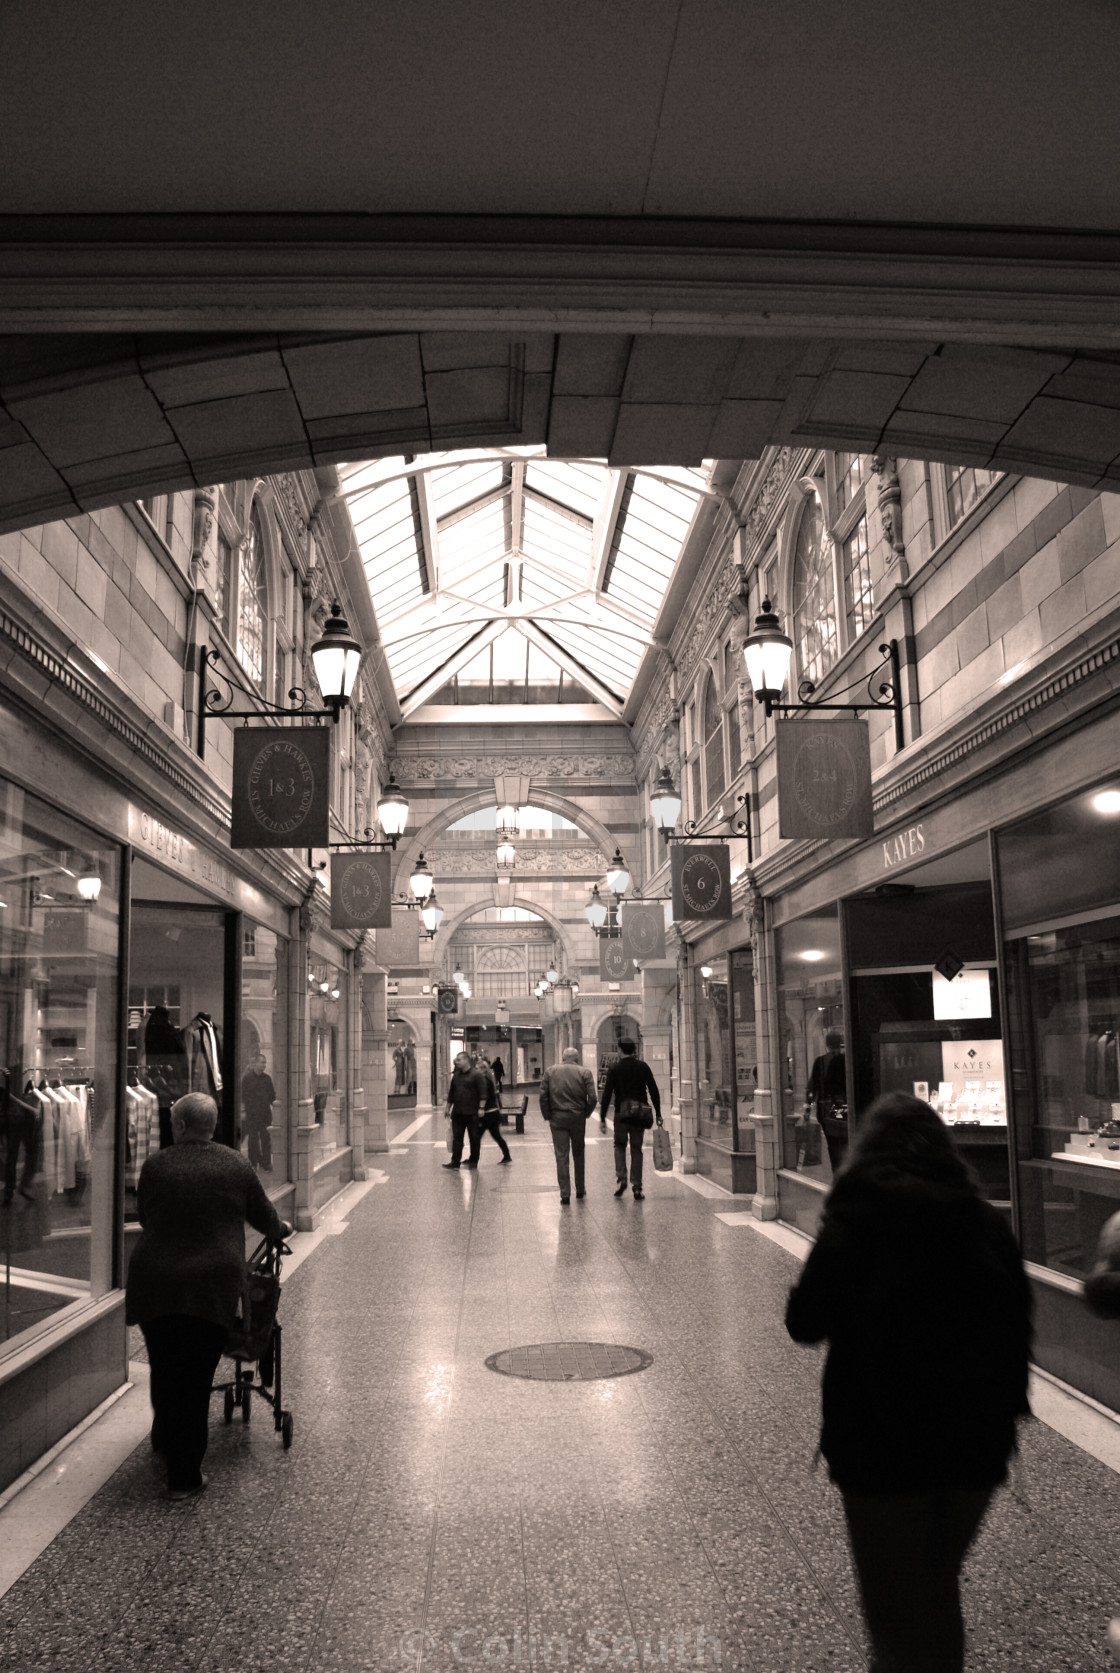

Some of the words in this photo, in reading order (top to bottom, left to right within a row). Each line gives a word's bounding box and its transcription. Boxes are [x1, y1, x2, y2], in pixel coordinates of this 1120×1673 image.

[251, 749, 273, 784] GIEVES
[283, 744, 310, 782] HAWKES
[298, 788, 311, 812] ROW
[883, 824, 925, 868] KAYES
[684, 856, 716, 872] EVERWELL
[697, 876, 706, 890] 6
[640, 927, 647, 938] 8
[613, 955, 622, 964] 10
[953, 1061, 992, 1070] KAYES
